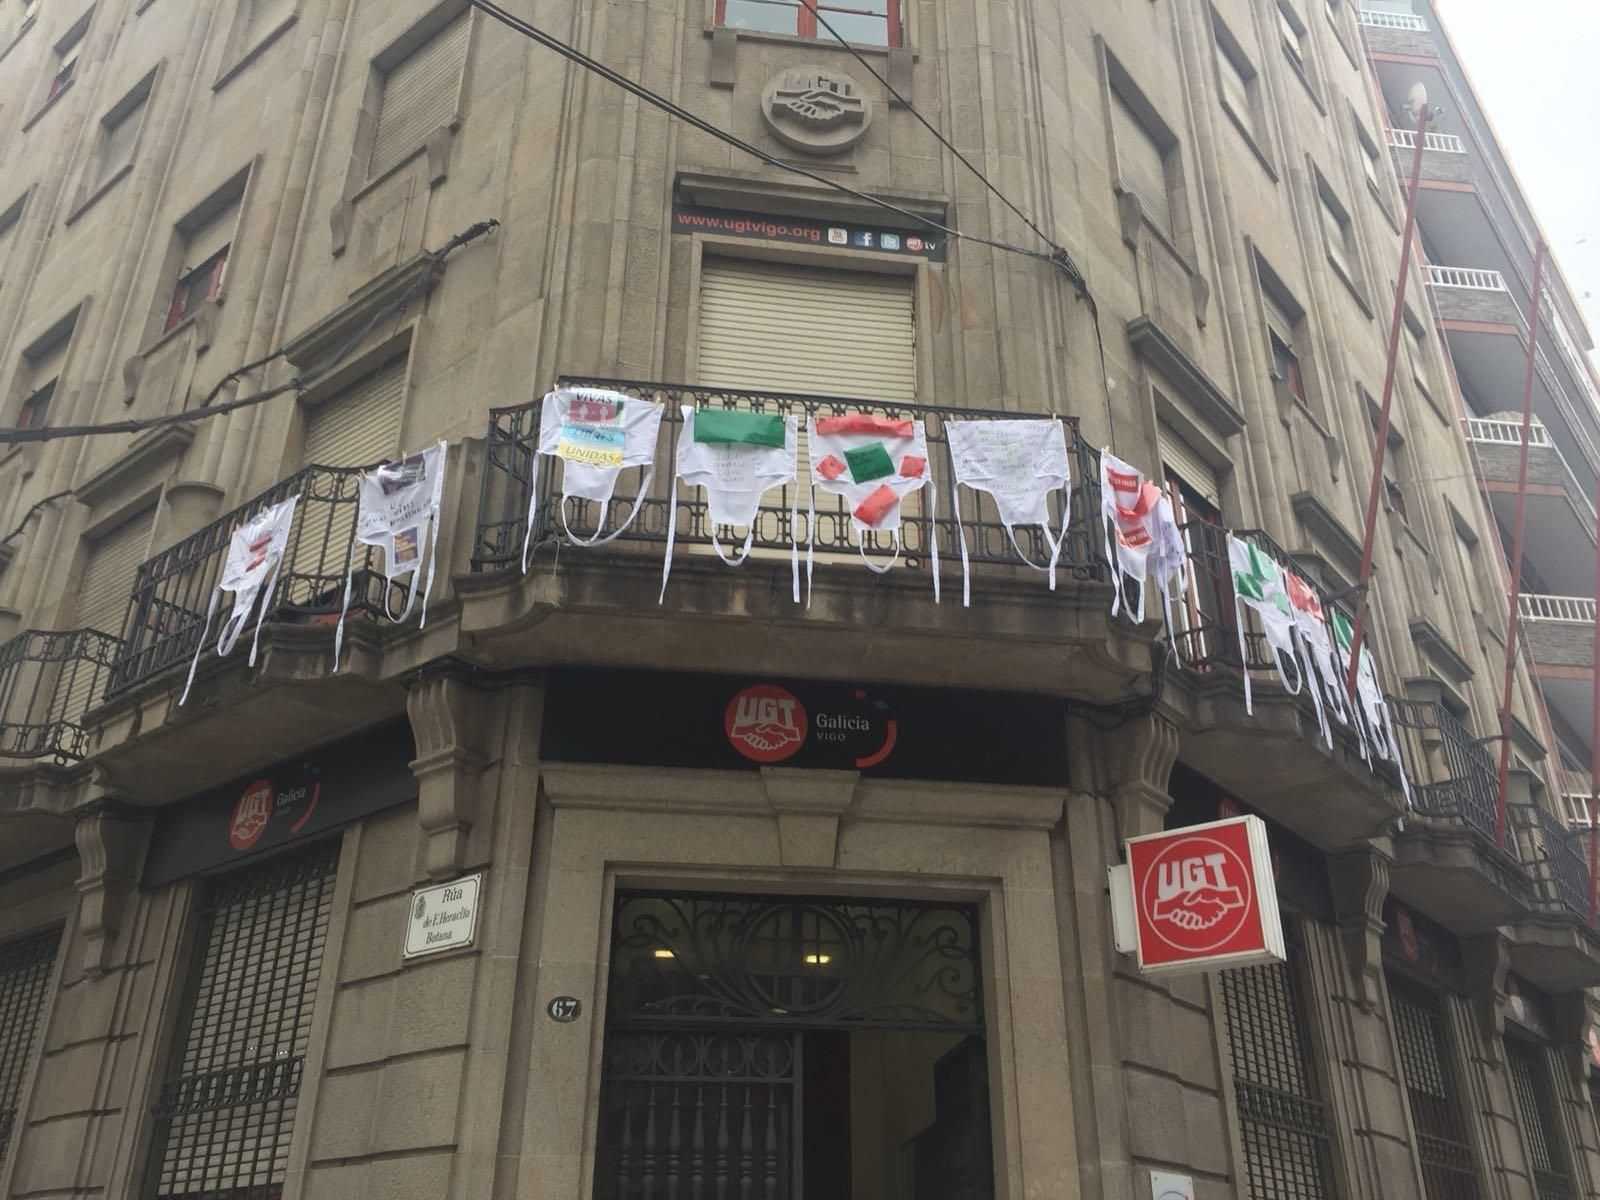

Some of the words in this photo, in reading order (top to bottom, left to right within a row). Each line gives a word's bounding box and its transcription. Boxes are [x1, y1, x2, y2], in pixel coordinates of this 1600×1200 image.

[784, 72, 851, 96] UGT
[678, 213, 821, 241] www.ugtvigo.org
[925, 237, 936, 250] tv
[576, 392, 613, 405] VIVAS
[566, 446, 616, 461] UNIDAS
[735, 696, 796, 729] UGT
[816, 713, 870, 731] Galicia
[817, 732, 846, 742] VIGO
[277, 786, 306, 807] Galicia
[235, 788, 270, 824] UGT
[1158, 852, 1226, 900] UGT
[442, 887, 463, 904] Rúa
[423, 915, 432, 928] de
[426, 931, 452, 944] Botana
[552, 1001, 577, 1017] 67
